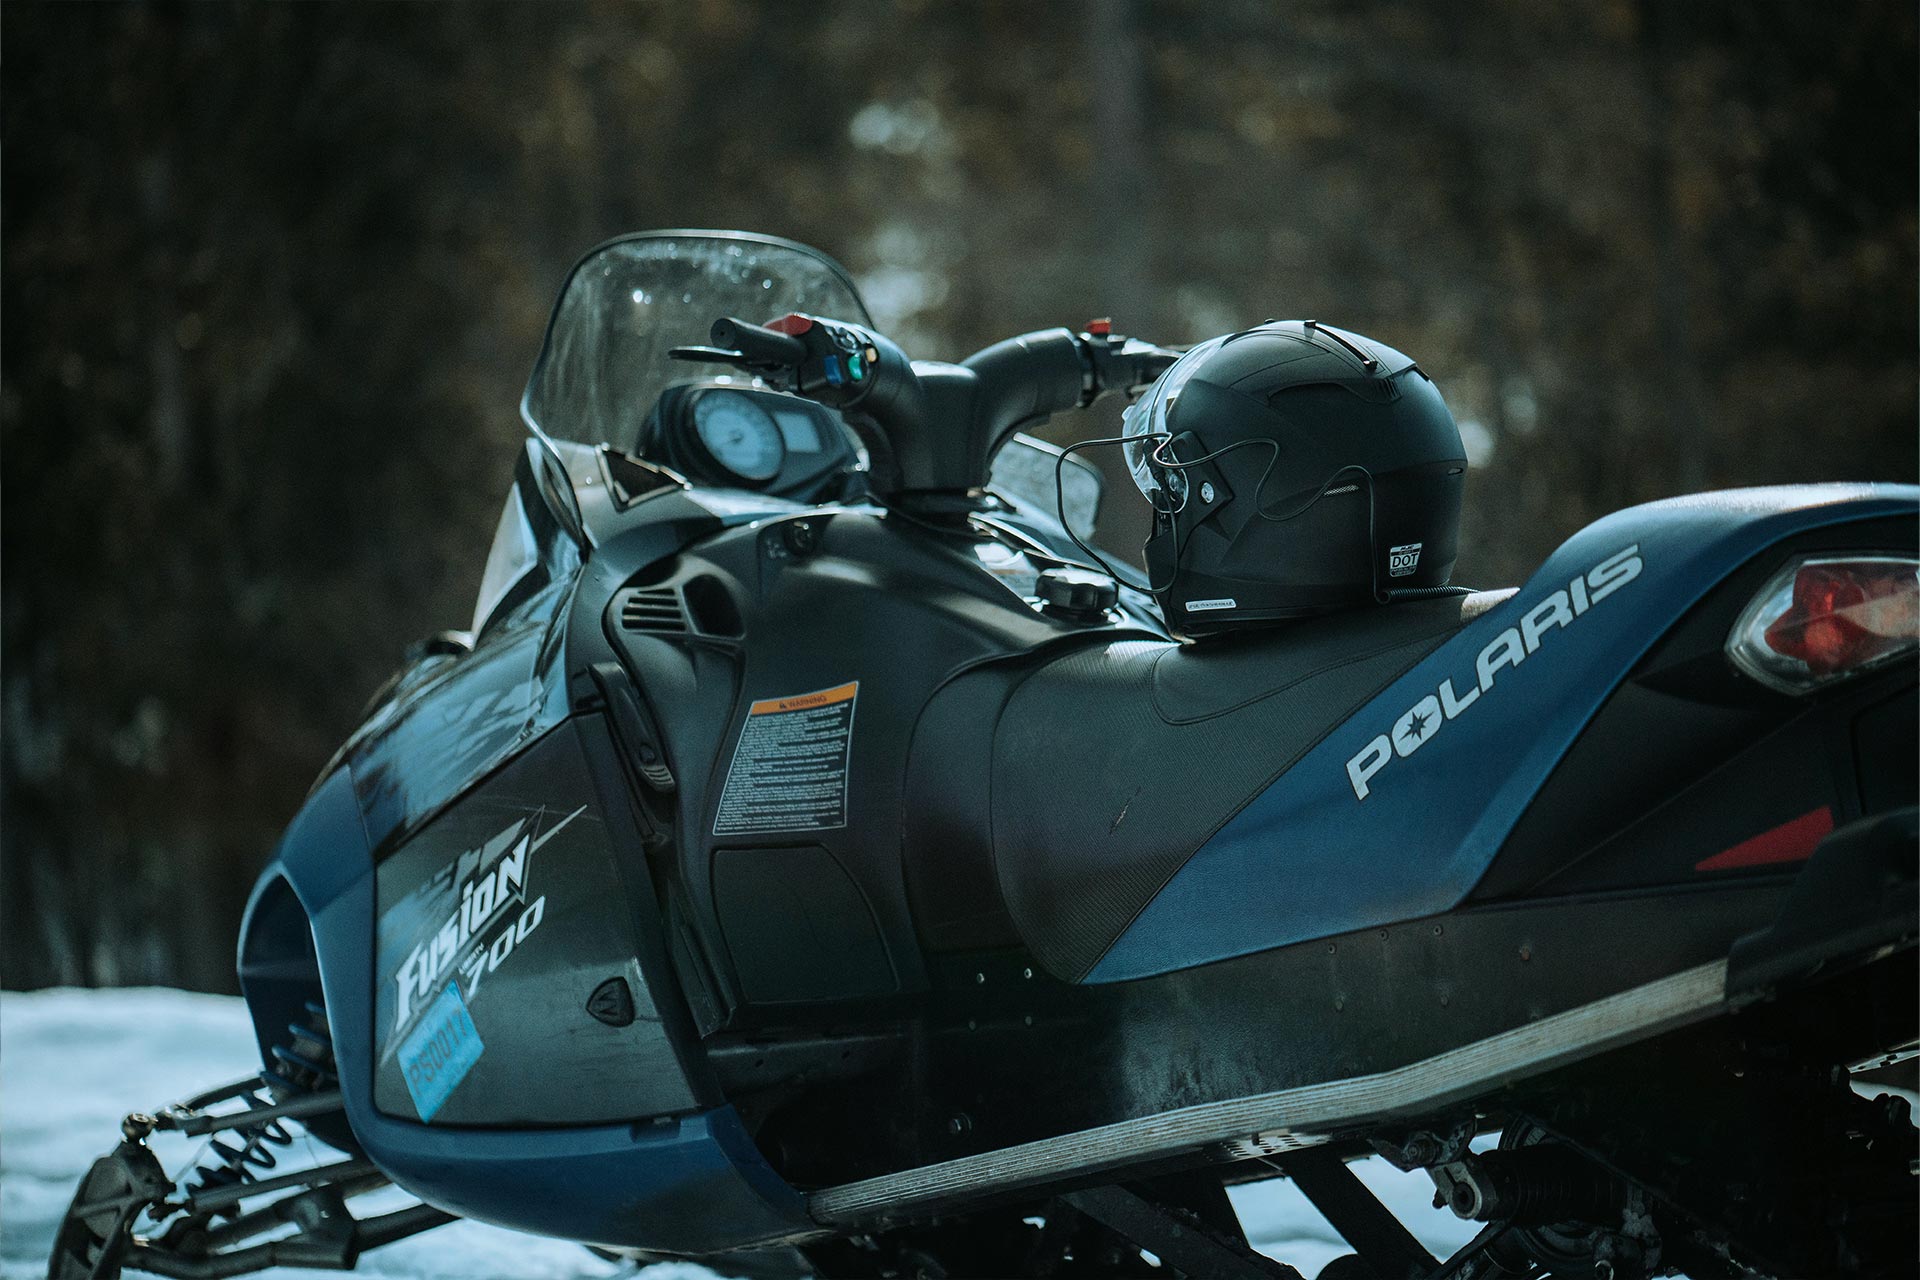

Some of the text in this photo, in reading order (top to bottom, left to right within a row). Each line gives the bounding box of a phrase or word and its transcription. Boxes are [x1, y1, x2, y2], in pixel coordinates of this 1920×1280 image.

[1392, 553, 1418, 567] DOT
[1346, 543, 1644, 800] POLARIS
[789, 696, 827, 707] WARNING
[465, 895, 546, 997] 700
